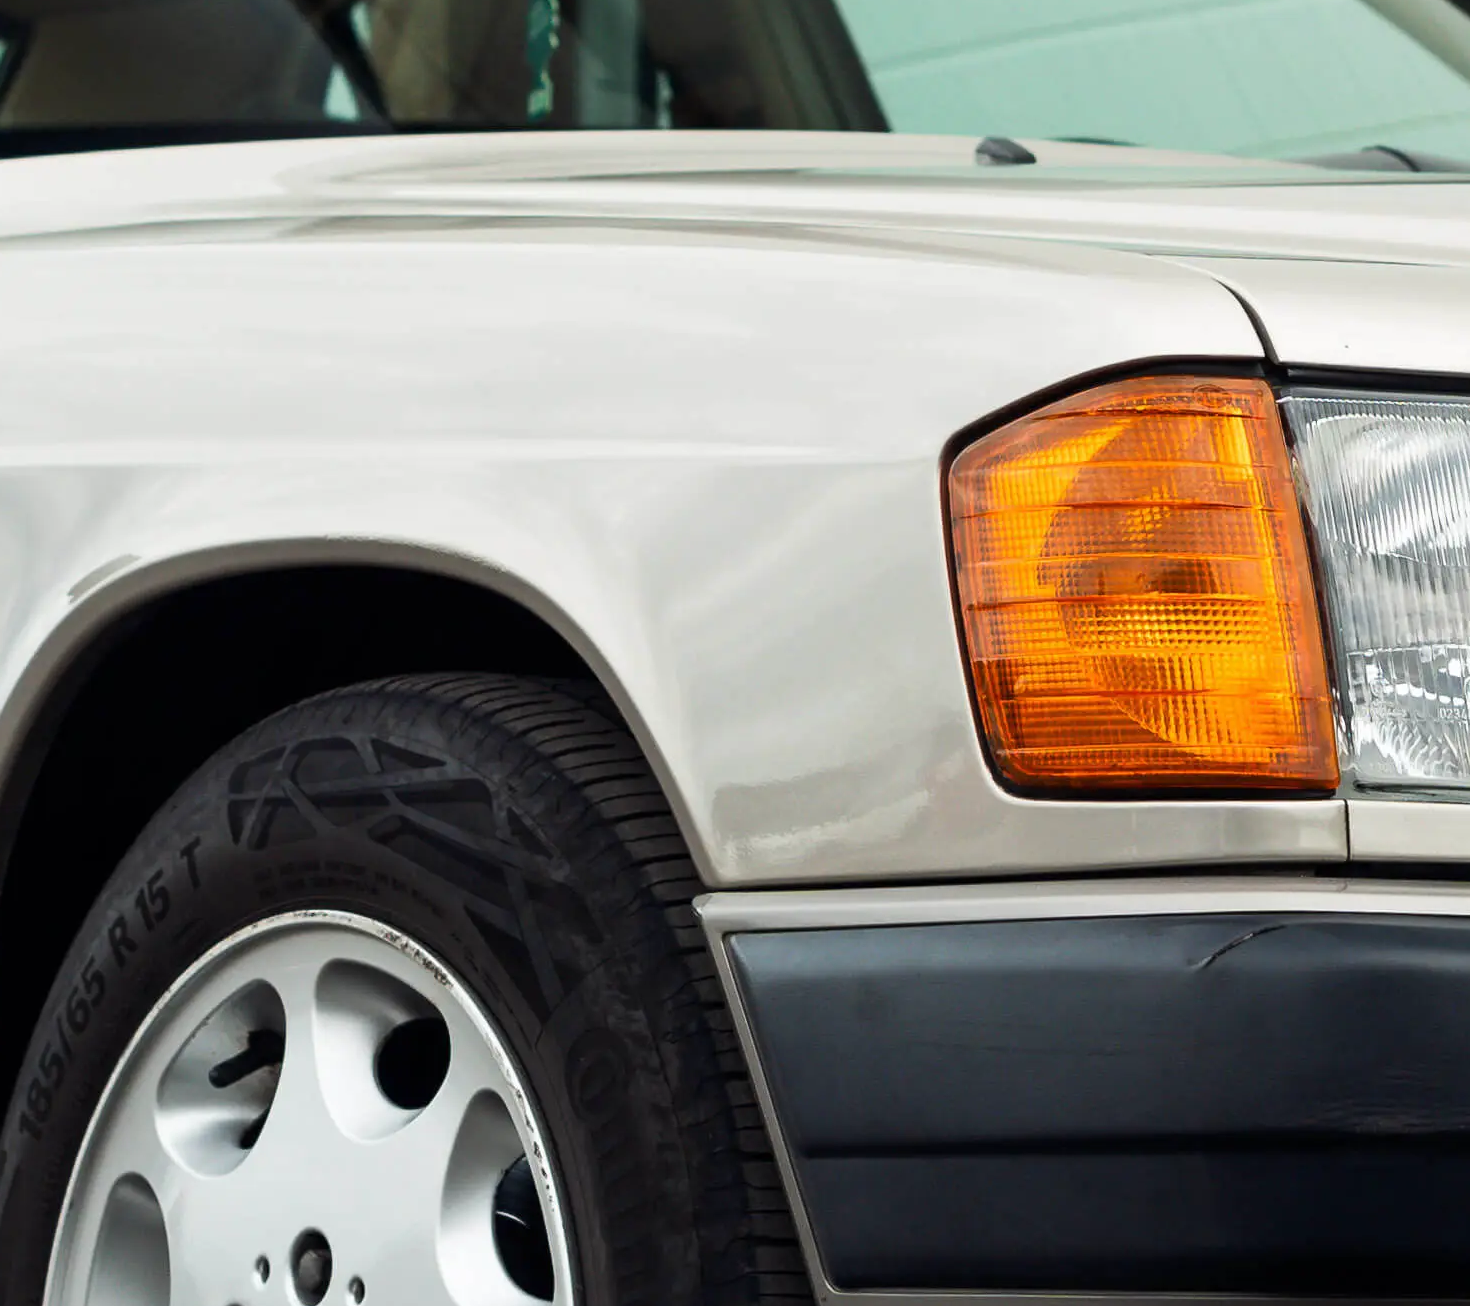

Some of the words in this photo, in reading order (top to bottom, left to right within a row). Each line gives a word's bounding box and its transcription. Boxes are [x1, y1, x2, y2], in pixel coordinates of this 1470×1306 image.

[18, 956, 106, 1142] 185/65
[108, 915, 138, 969] R
[135, 867, 170, 932] 15
[179, 835, 202, 892] T
